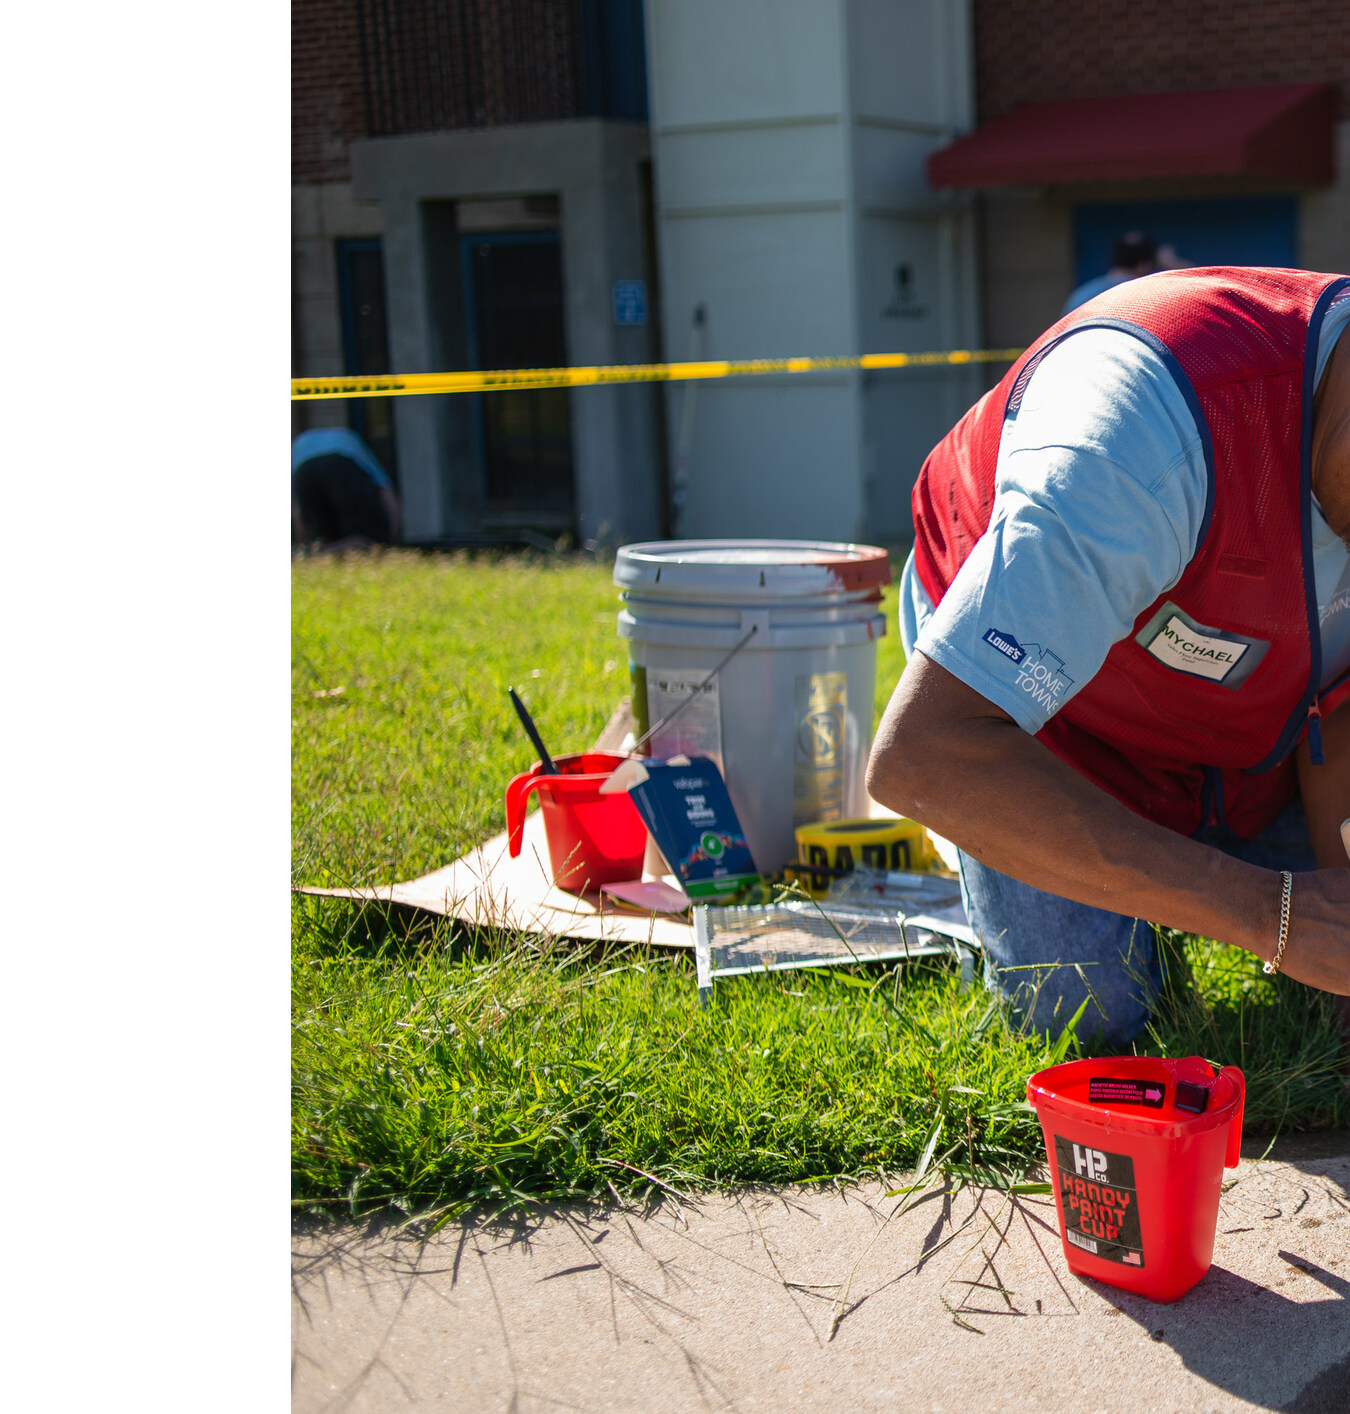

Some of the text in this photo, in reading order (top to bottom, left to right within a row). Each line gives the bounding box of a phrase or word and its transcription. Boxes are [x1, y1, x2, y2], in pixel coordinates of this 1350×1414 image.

[987, 631, 1022, 661] LOWE'S
[1161, 625, 1234, 664] MYCHAEL
[1022, 656, 1064, 697] HOME
[1073, 1143, 1108, 1179] HP
[1095, 1172, 1110, 1183] CO.
[1063, 1172, 1130, 1209] HANDY
[1069, 1193, 1126, 1227] PAINT
[1080, 1215, 1119, 1241] CUP
